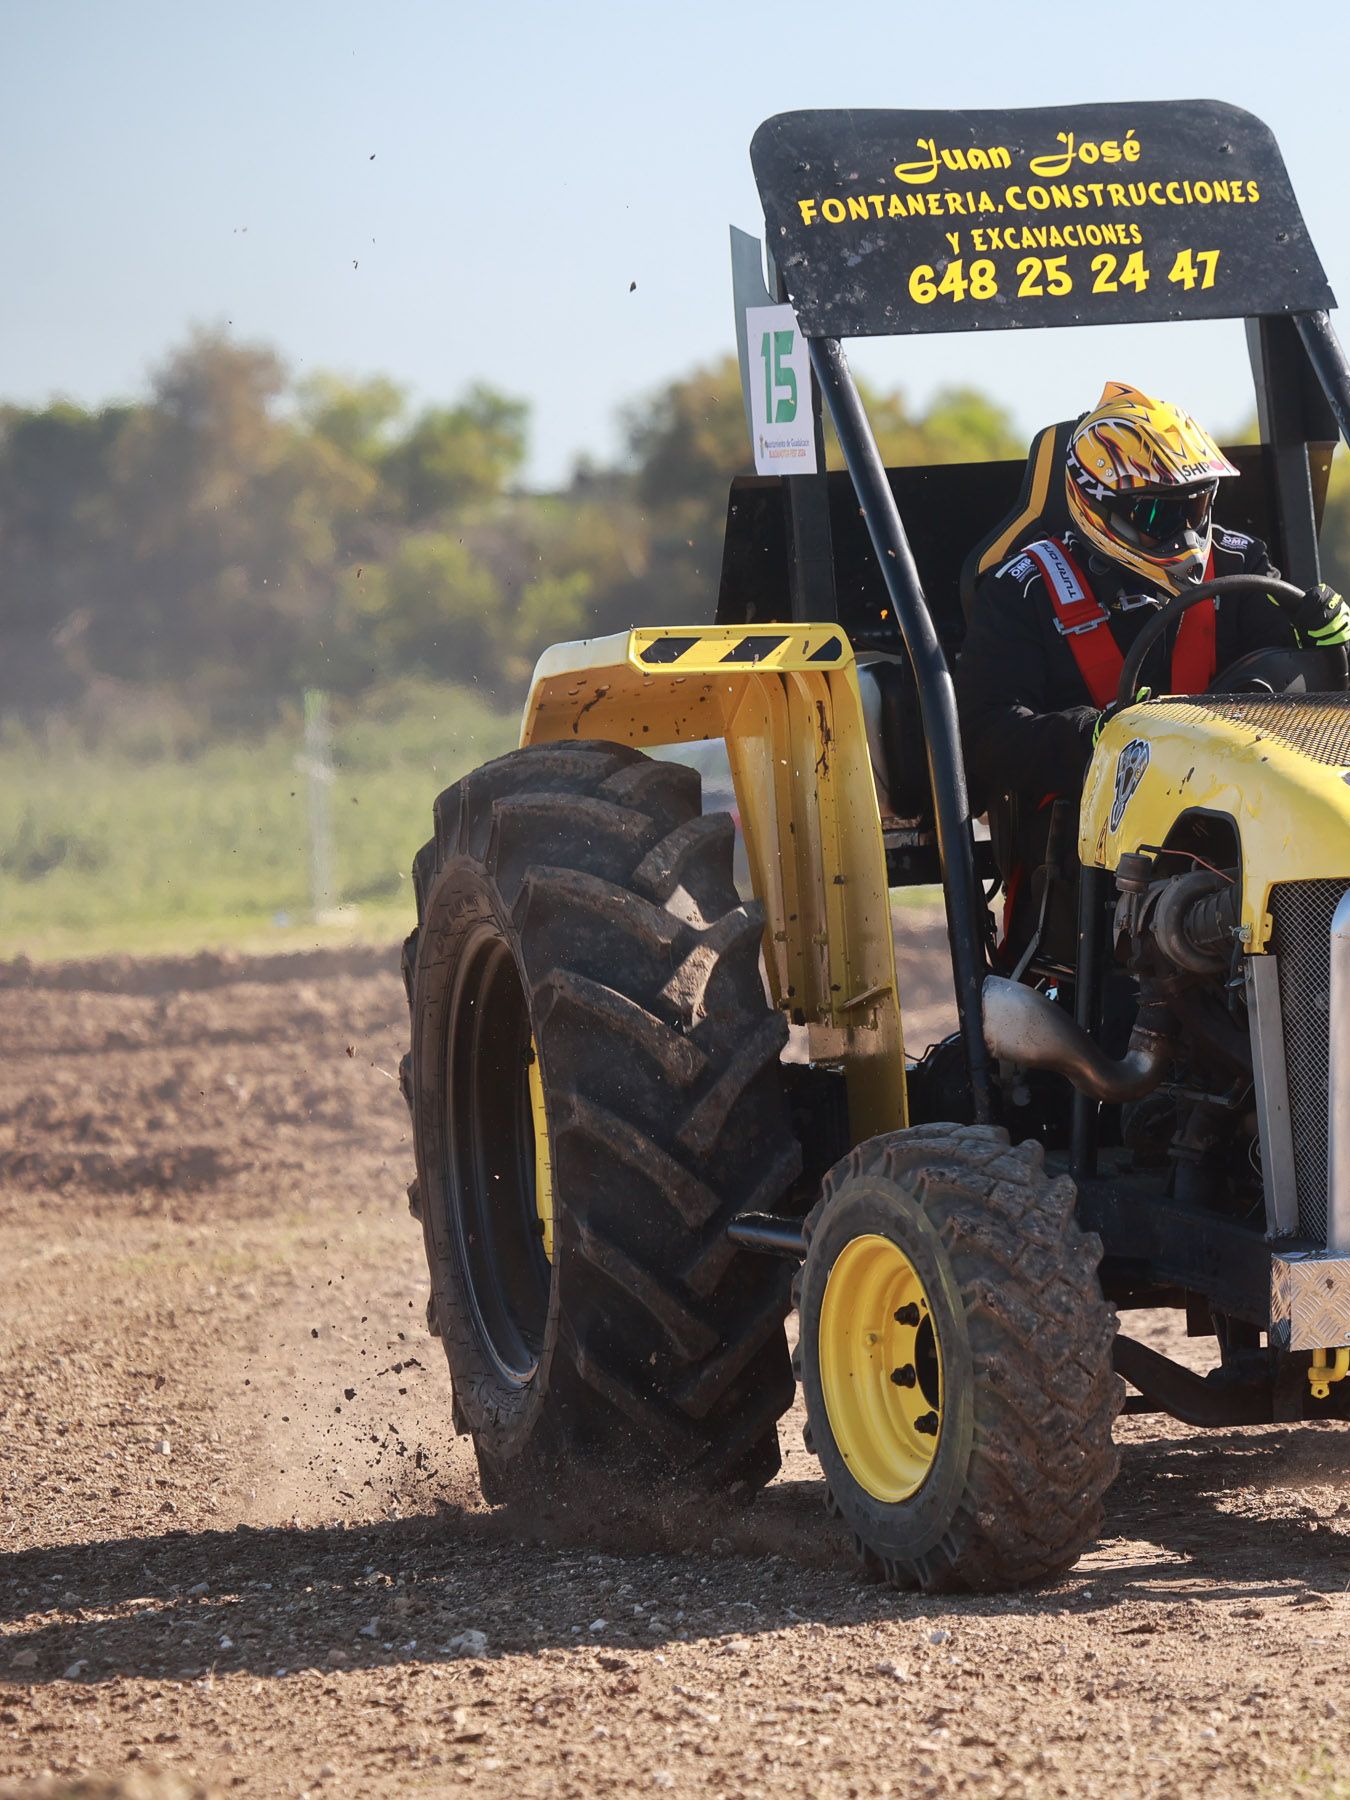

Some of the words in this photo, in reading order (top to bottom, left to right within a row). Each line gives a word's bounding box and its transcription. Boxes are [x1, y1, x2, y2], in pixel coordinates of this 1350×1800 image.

[895, 138, 1013, 185] Juan
[1030, 130, 1141, 178] José
[946, 233, 961, 255] Y
[972, 223, 1143, 252] EXCAVACIONES
[908, 258, 999, 305] 648
[1016, 254, 1073, 298] 25
[1091, 250, 1150, 294] 24
[1168, 248, 1221, 290] 47
[760, 330, 798, 424] 15
[1222, 535, 1249, 547] OMP
[1011, 556, 1031, 578] OMP
[1055, 562, 1077, 599] TURN
